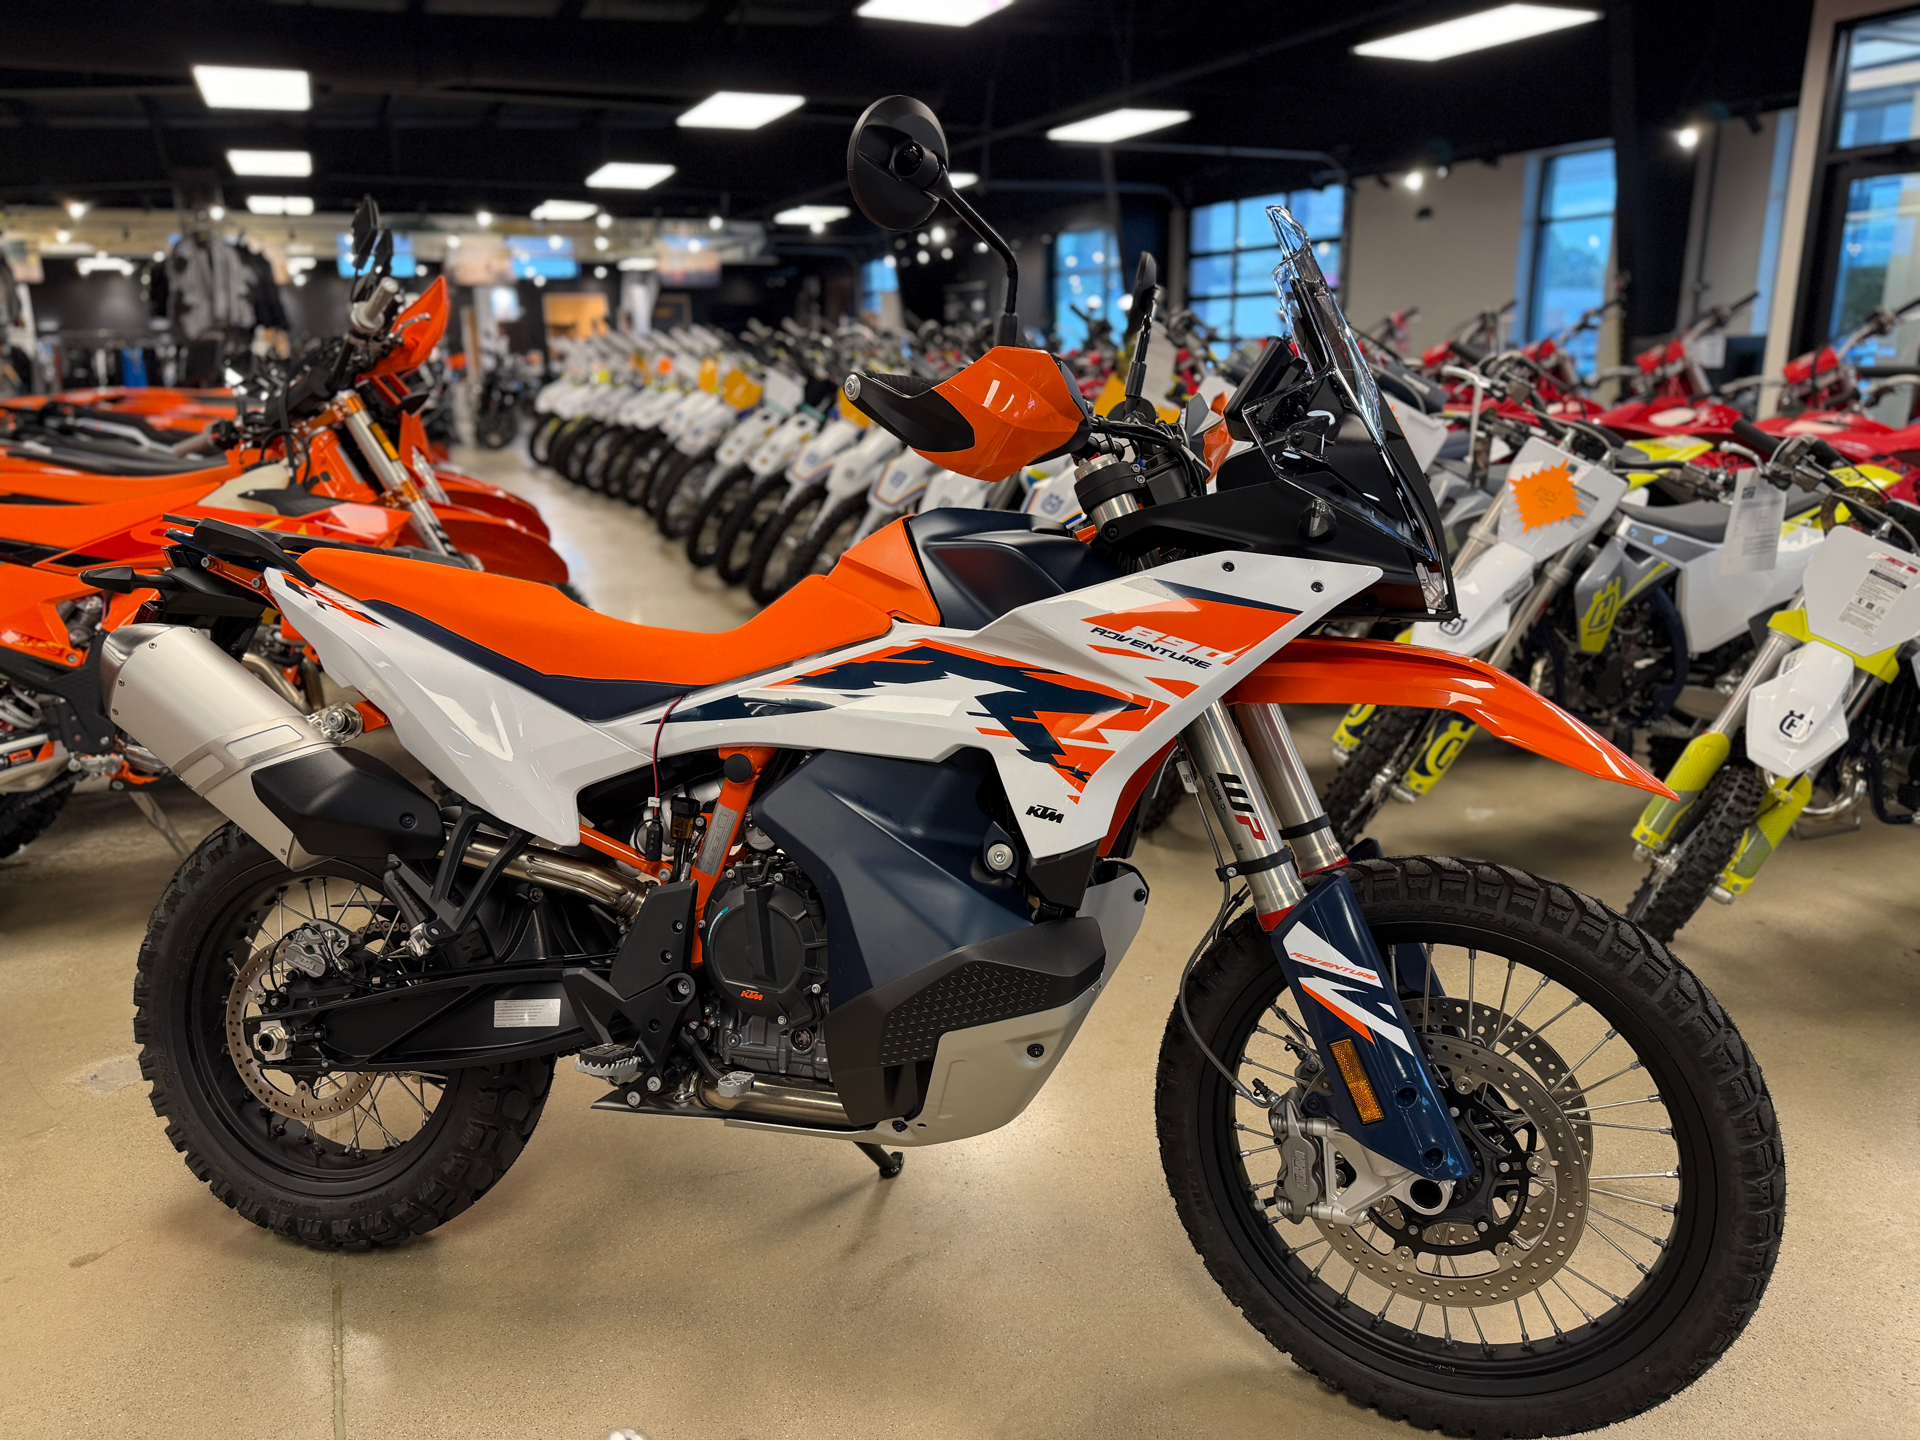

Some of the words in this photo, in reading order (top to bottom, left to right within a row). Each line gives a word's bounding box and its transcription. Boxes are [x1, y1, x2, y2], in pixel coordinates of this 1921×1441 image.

[1090, 626, 1213, 669] ADVENTURE
[1127, 625, 1236, 664] 890
[1025, 804, 1065, 824] KTM
[1216, 771, 1268, 841] WP
[1289, 952, 1379, 981] ADVENTURE
[740, 989, 764, 1002] KTM
[1292, 1149, 1308, 1192] KTM
